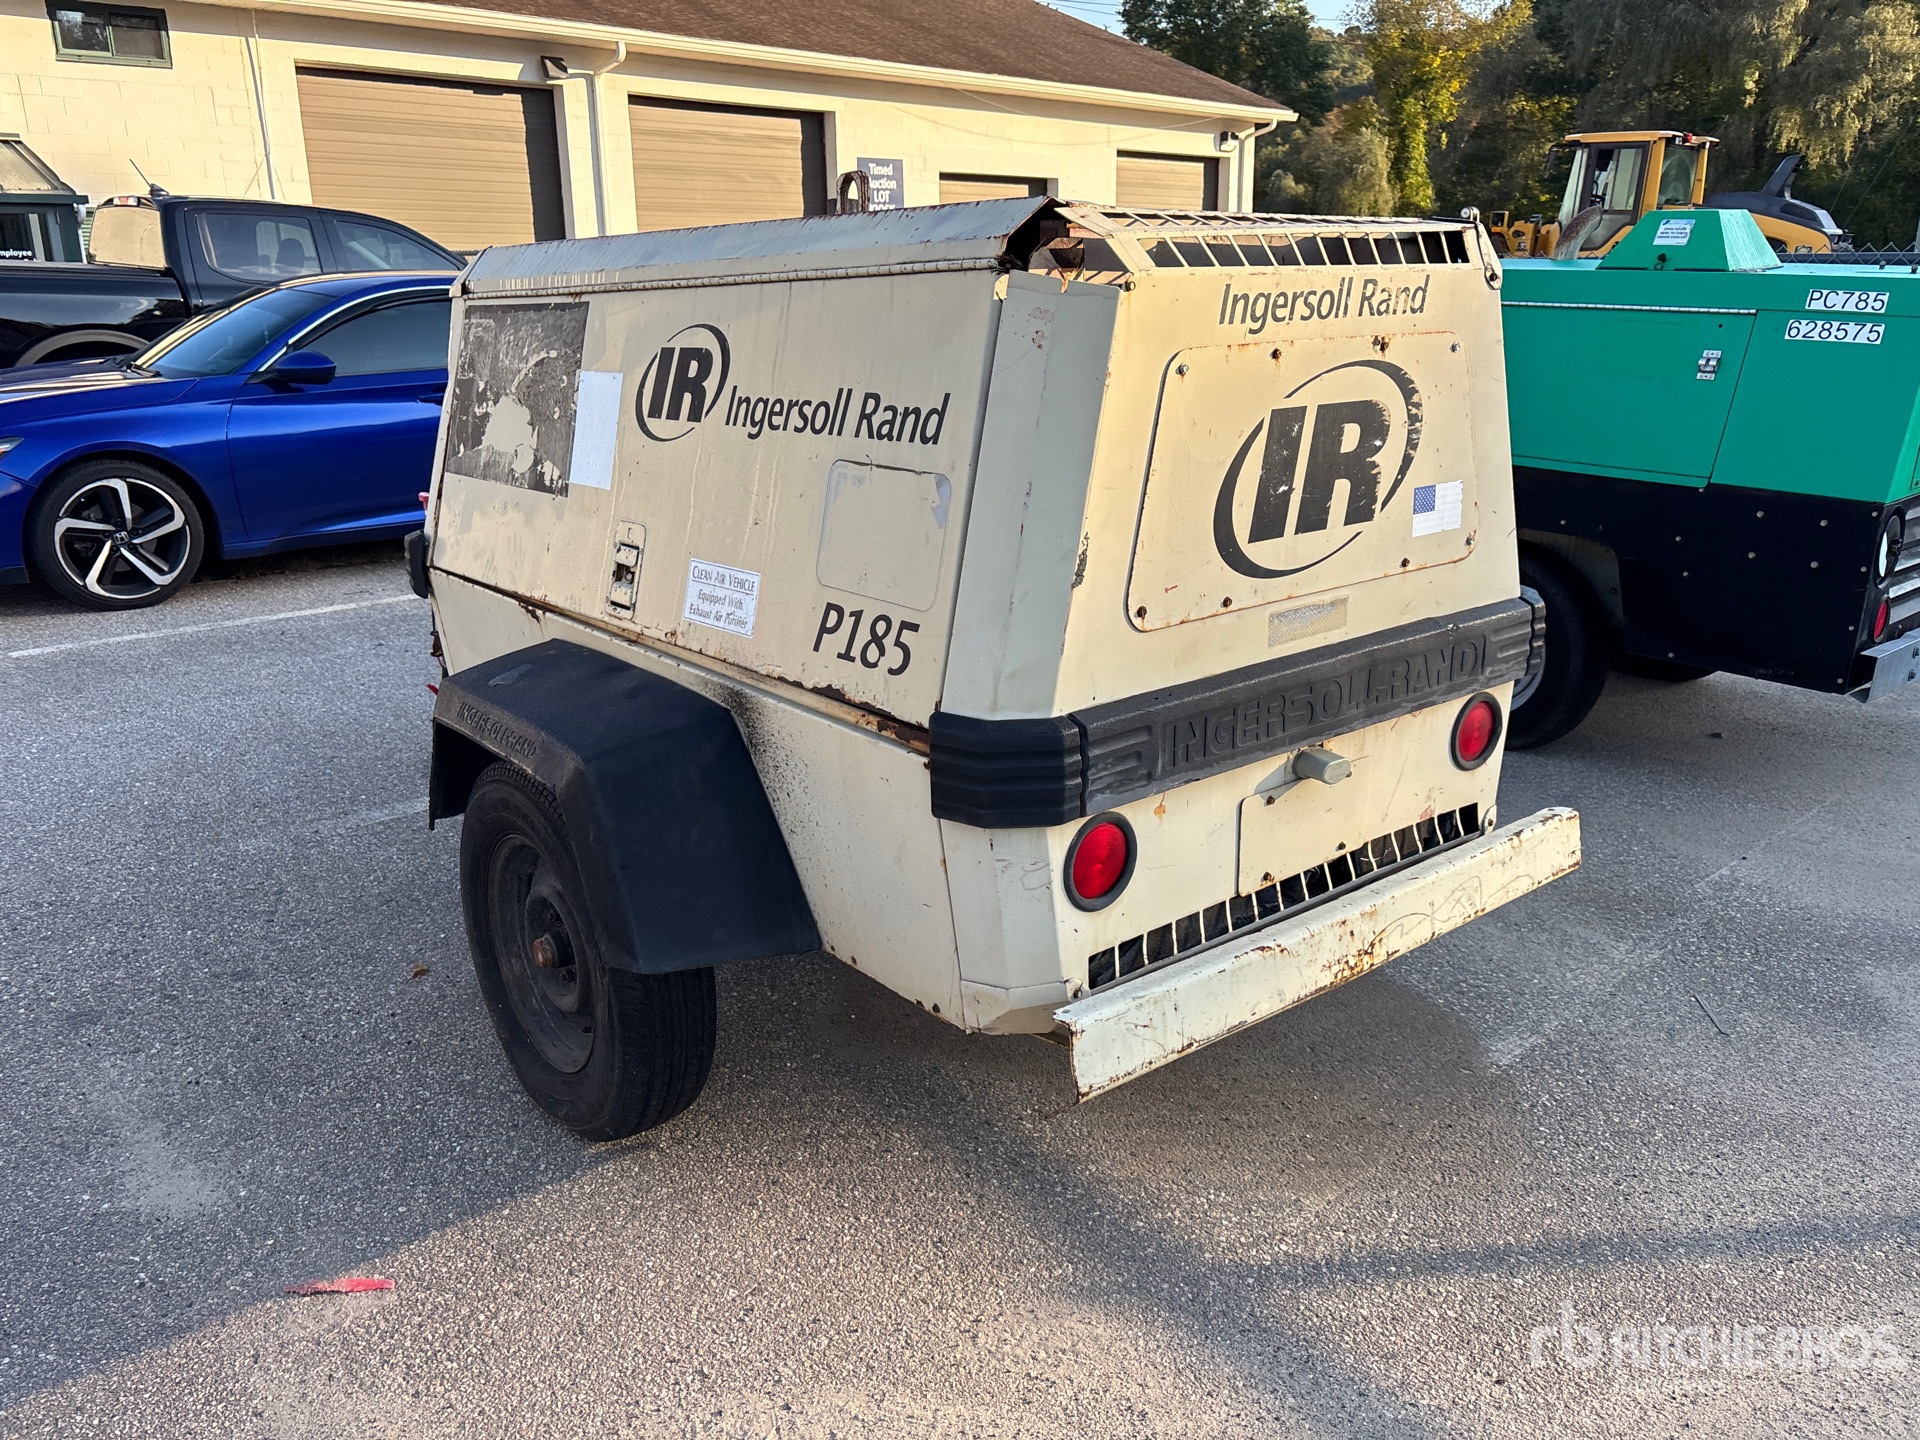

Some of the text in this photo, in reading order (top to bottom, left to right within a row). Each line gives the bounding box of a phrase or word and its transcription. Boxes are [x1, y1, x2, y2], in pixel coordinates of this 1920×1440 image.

[868, 163, 893, 176] Timed
[873, 190, 891, 203] LOT
[1218, 274, 1431, 335] Ingersoll Rand
[1807, 289, 1887, 311] PC785
[1787, 320, 1883, 343] 628575
[647, 346, 714, 423] IR
[725, 384, 951, 445] Ingersoll Rand
[1247, 399, 1392, 545] IR
[692, 565, 756, 592] CLEAN AIR VEHICLE
[698, 589, 727, 606] Equipped
[689, 603, 713, 620] Exhaust
[713, 610, 723, 622] Air
[813, 602, 920, 676] P185
